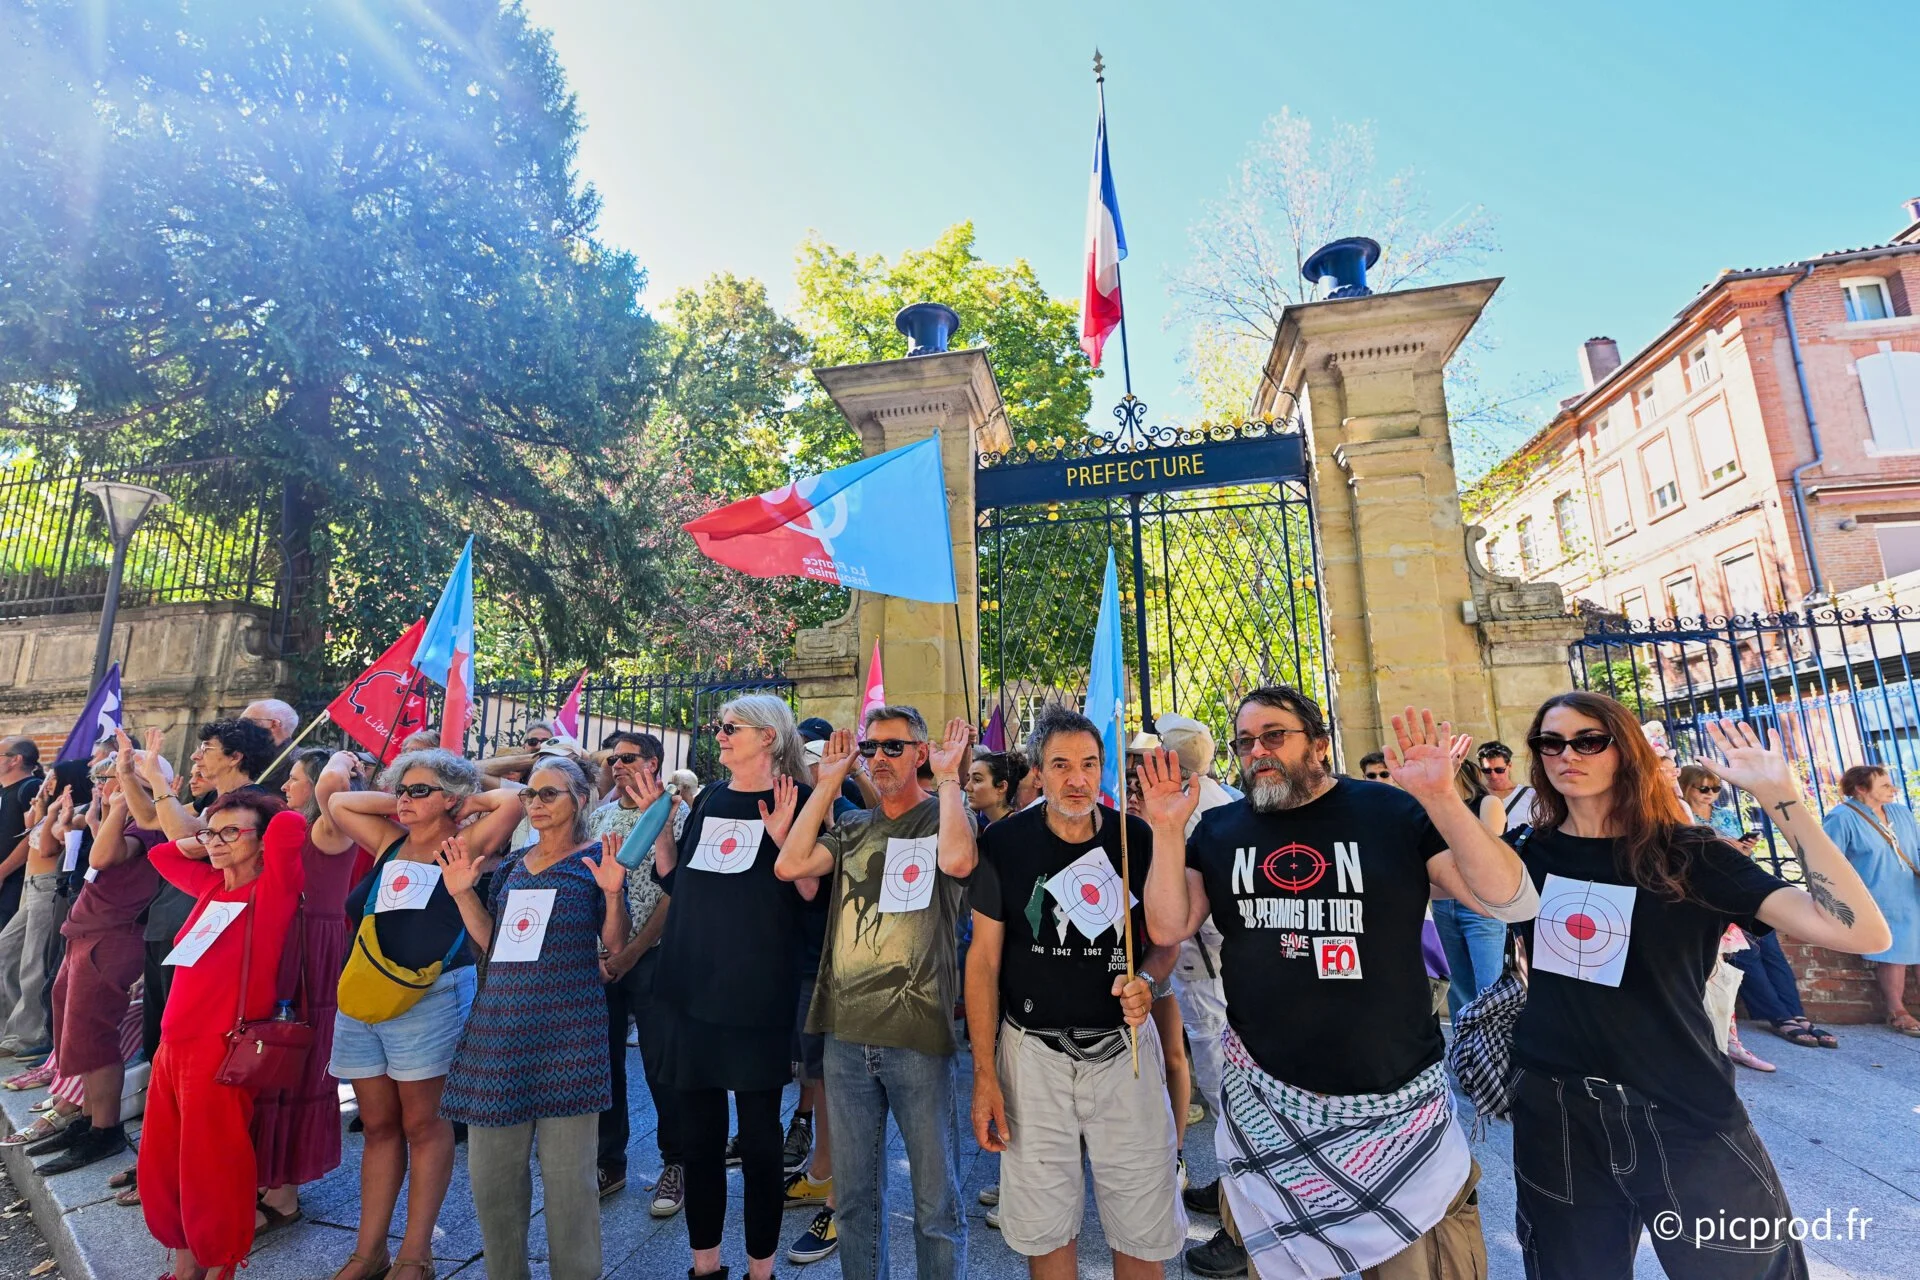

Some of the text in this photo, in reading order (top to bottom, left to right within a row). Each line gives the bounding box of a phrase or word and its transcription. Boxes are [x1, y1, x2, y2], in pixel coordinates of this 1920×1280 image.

[1066, 454, 1205, 487] PREFECTURE
[1255, 897, 1305, 930] PERMIS
[1307, 898, 1326, 931] DE
[1327, 898, 1364, 934] TUER
[1052, 947, 1072, 956] 1947
[1083, 948, 1102, 956] 1967
[1322, 944, 1356, 977] FO
[1107, 963, 1127, 972] JOUR
